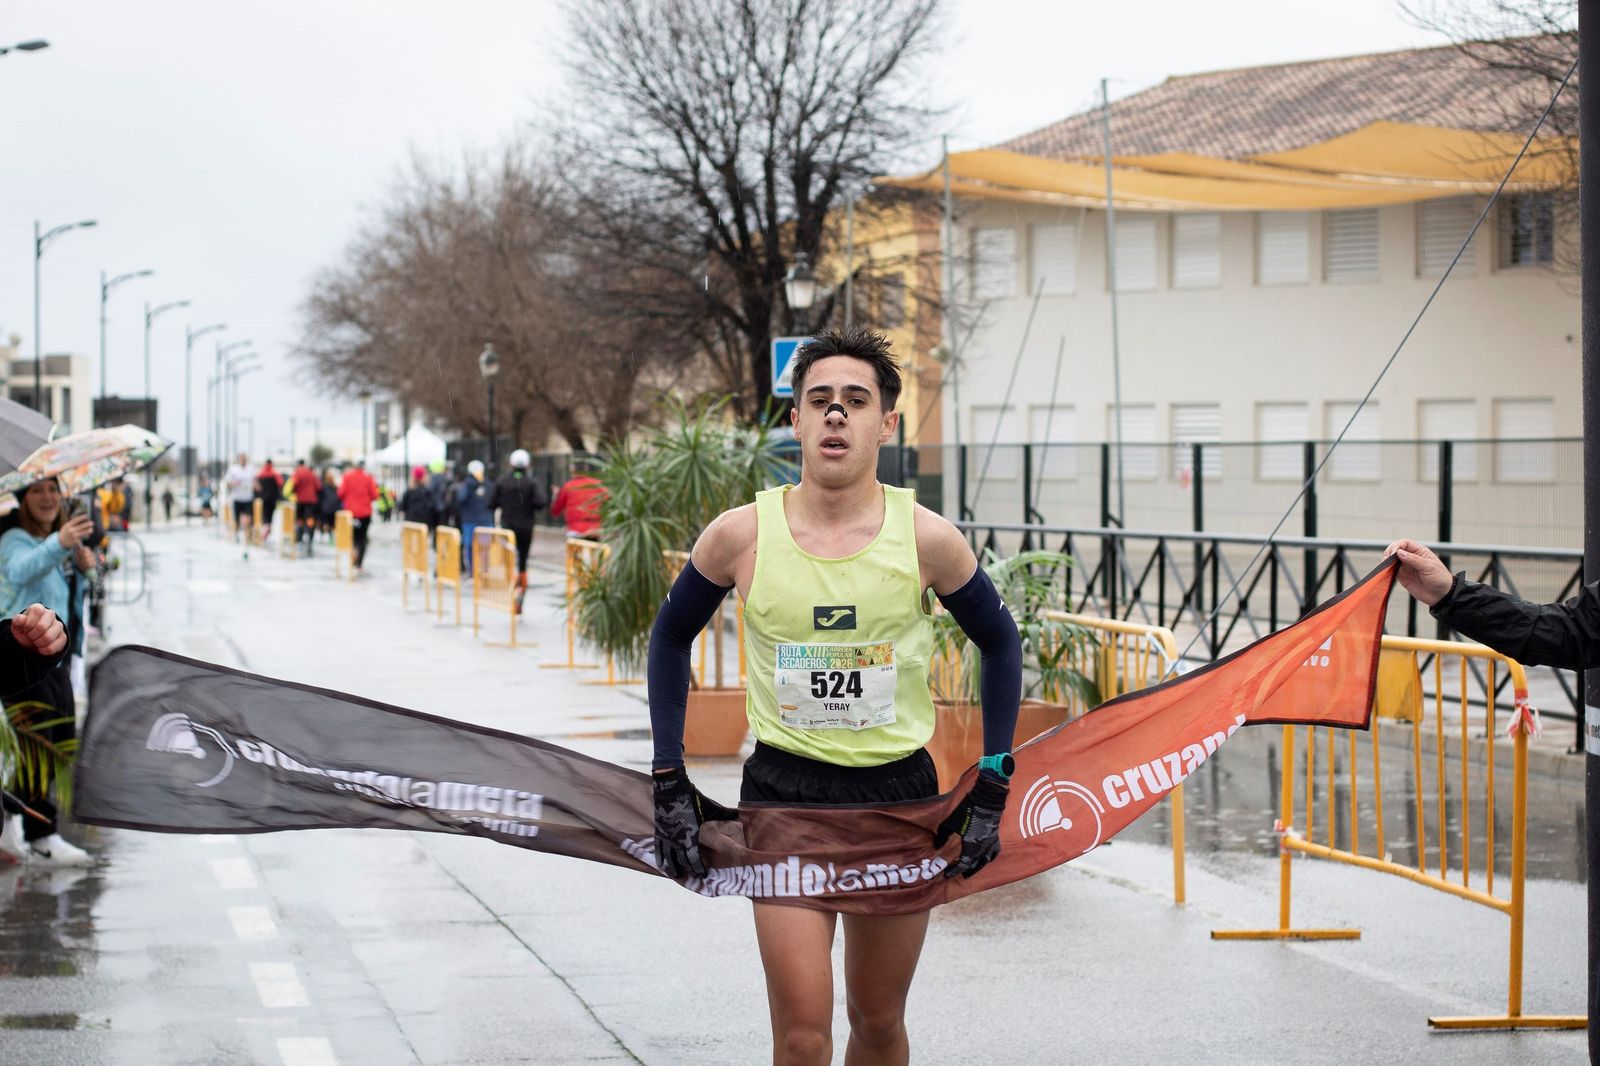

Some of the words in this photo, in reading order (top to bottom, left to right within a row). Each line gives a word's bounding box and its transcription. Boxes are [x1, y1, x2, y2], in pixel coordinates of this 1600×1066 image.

[780, 646, 802, 658] RUTA
[804, 646, 827, 658] XIII
[780, 657, 828, 669] SECADEROS
[830, 658, 854, 669] 2026
[810, 671, 864, 698] 524
[823, 702, 851, 712] YERAY
